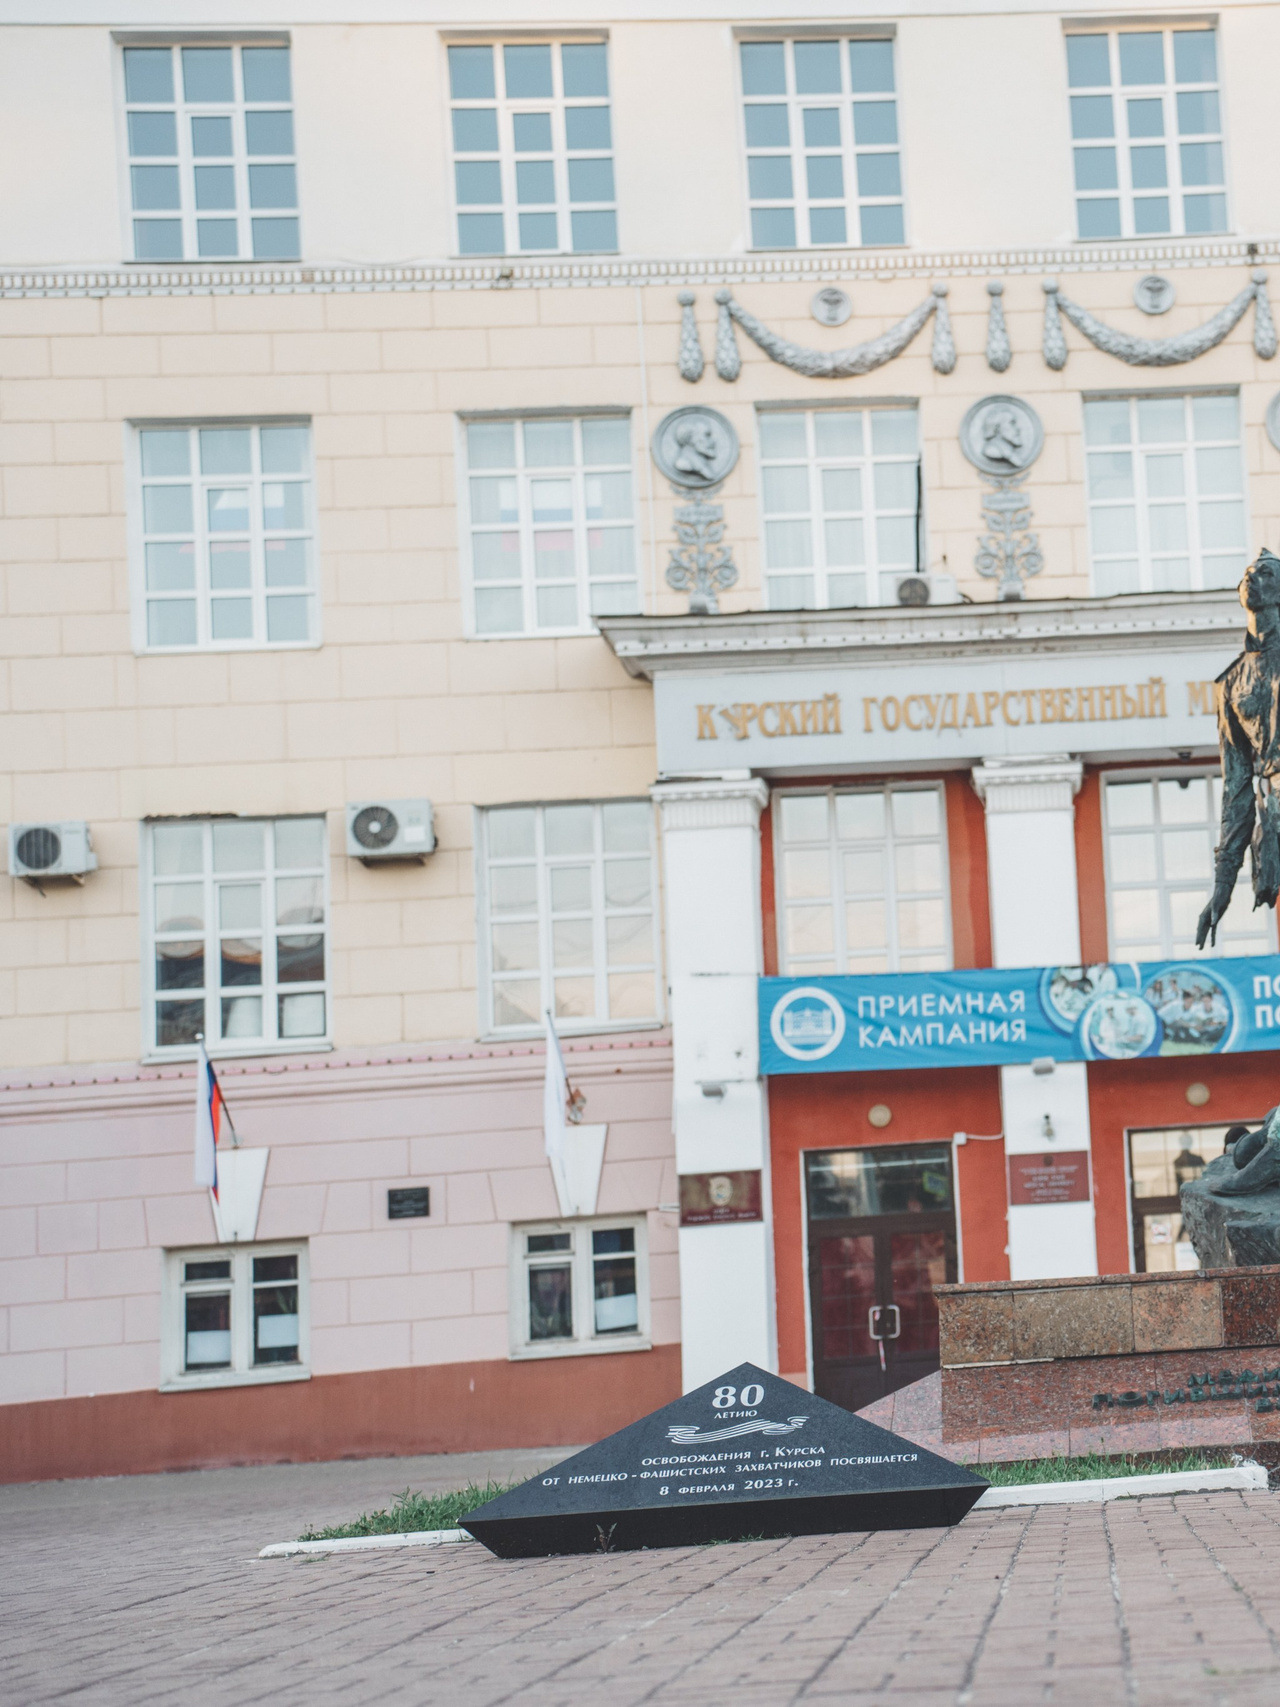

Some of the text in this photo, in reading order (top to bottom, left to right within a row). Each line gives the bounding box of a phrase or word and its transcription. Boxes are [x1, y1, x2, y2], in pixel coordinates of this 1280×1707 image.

[695, 692, 843, 741] КУРСКИЙ
[862, 677, 1168, 737] ГОСУДАРСТВЕННЫЙ
[857, 989, 1026, 1019] ПРИЕМНАЯ
[858, 1018, 1027, 1049] КАМПАНИЯ
[711, 1383, 765, 1409] 80
[714, 1409, 758, 1419] ЛЕТИЮ
[542, 1476, 560, 1487] ОТ
[734, 1458, 822, 1473] ЗАХВАТЧИКОВ
[830, 1453, 918, 1467] ПОСВЯЩАЕТСЯ
[641, 1450, 752, 1467] ОСВОБОЖДЕНИЯ
[659, 1485, 670, 1496] 8
[678, 1483, 735, 1495] ФЕВРАЛЯ
[744, 1478, 783, 1490] 2023
